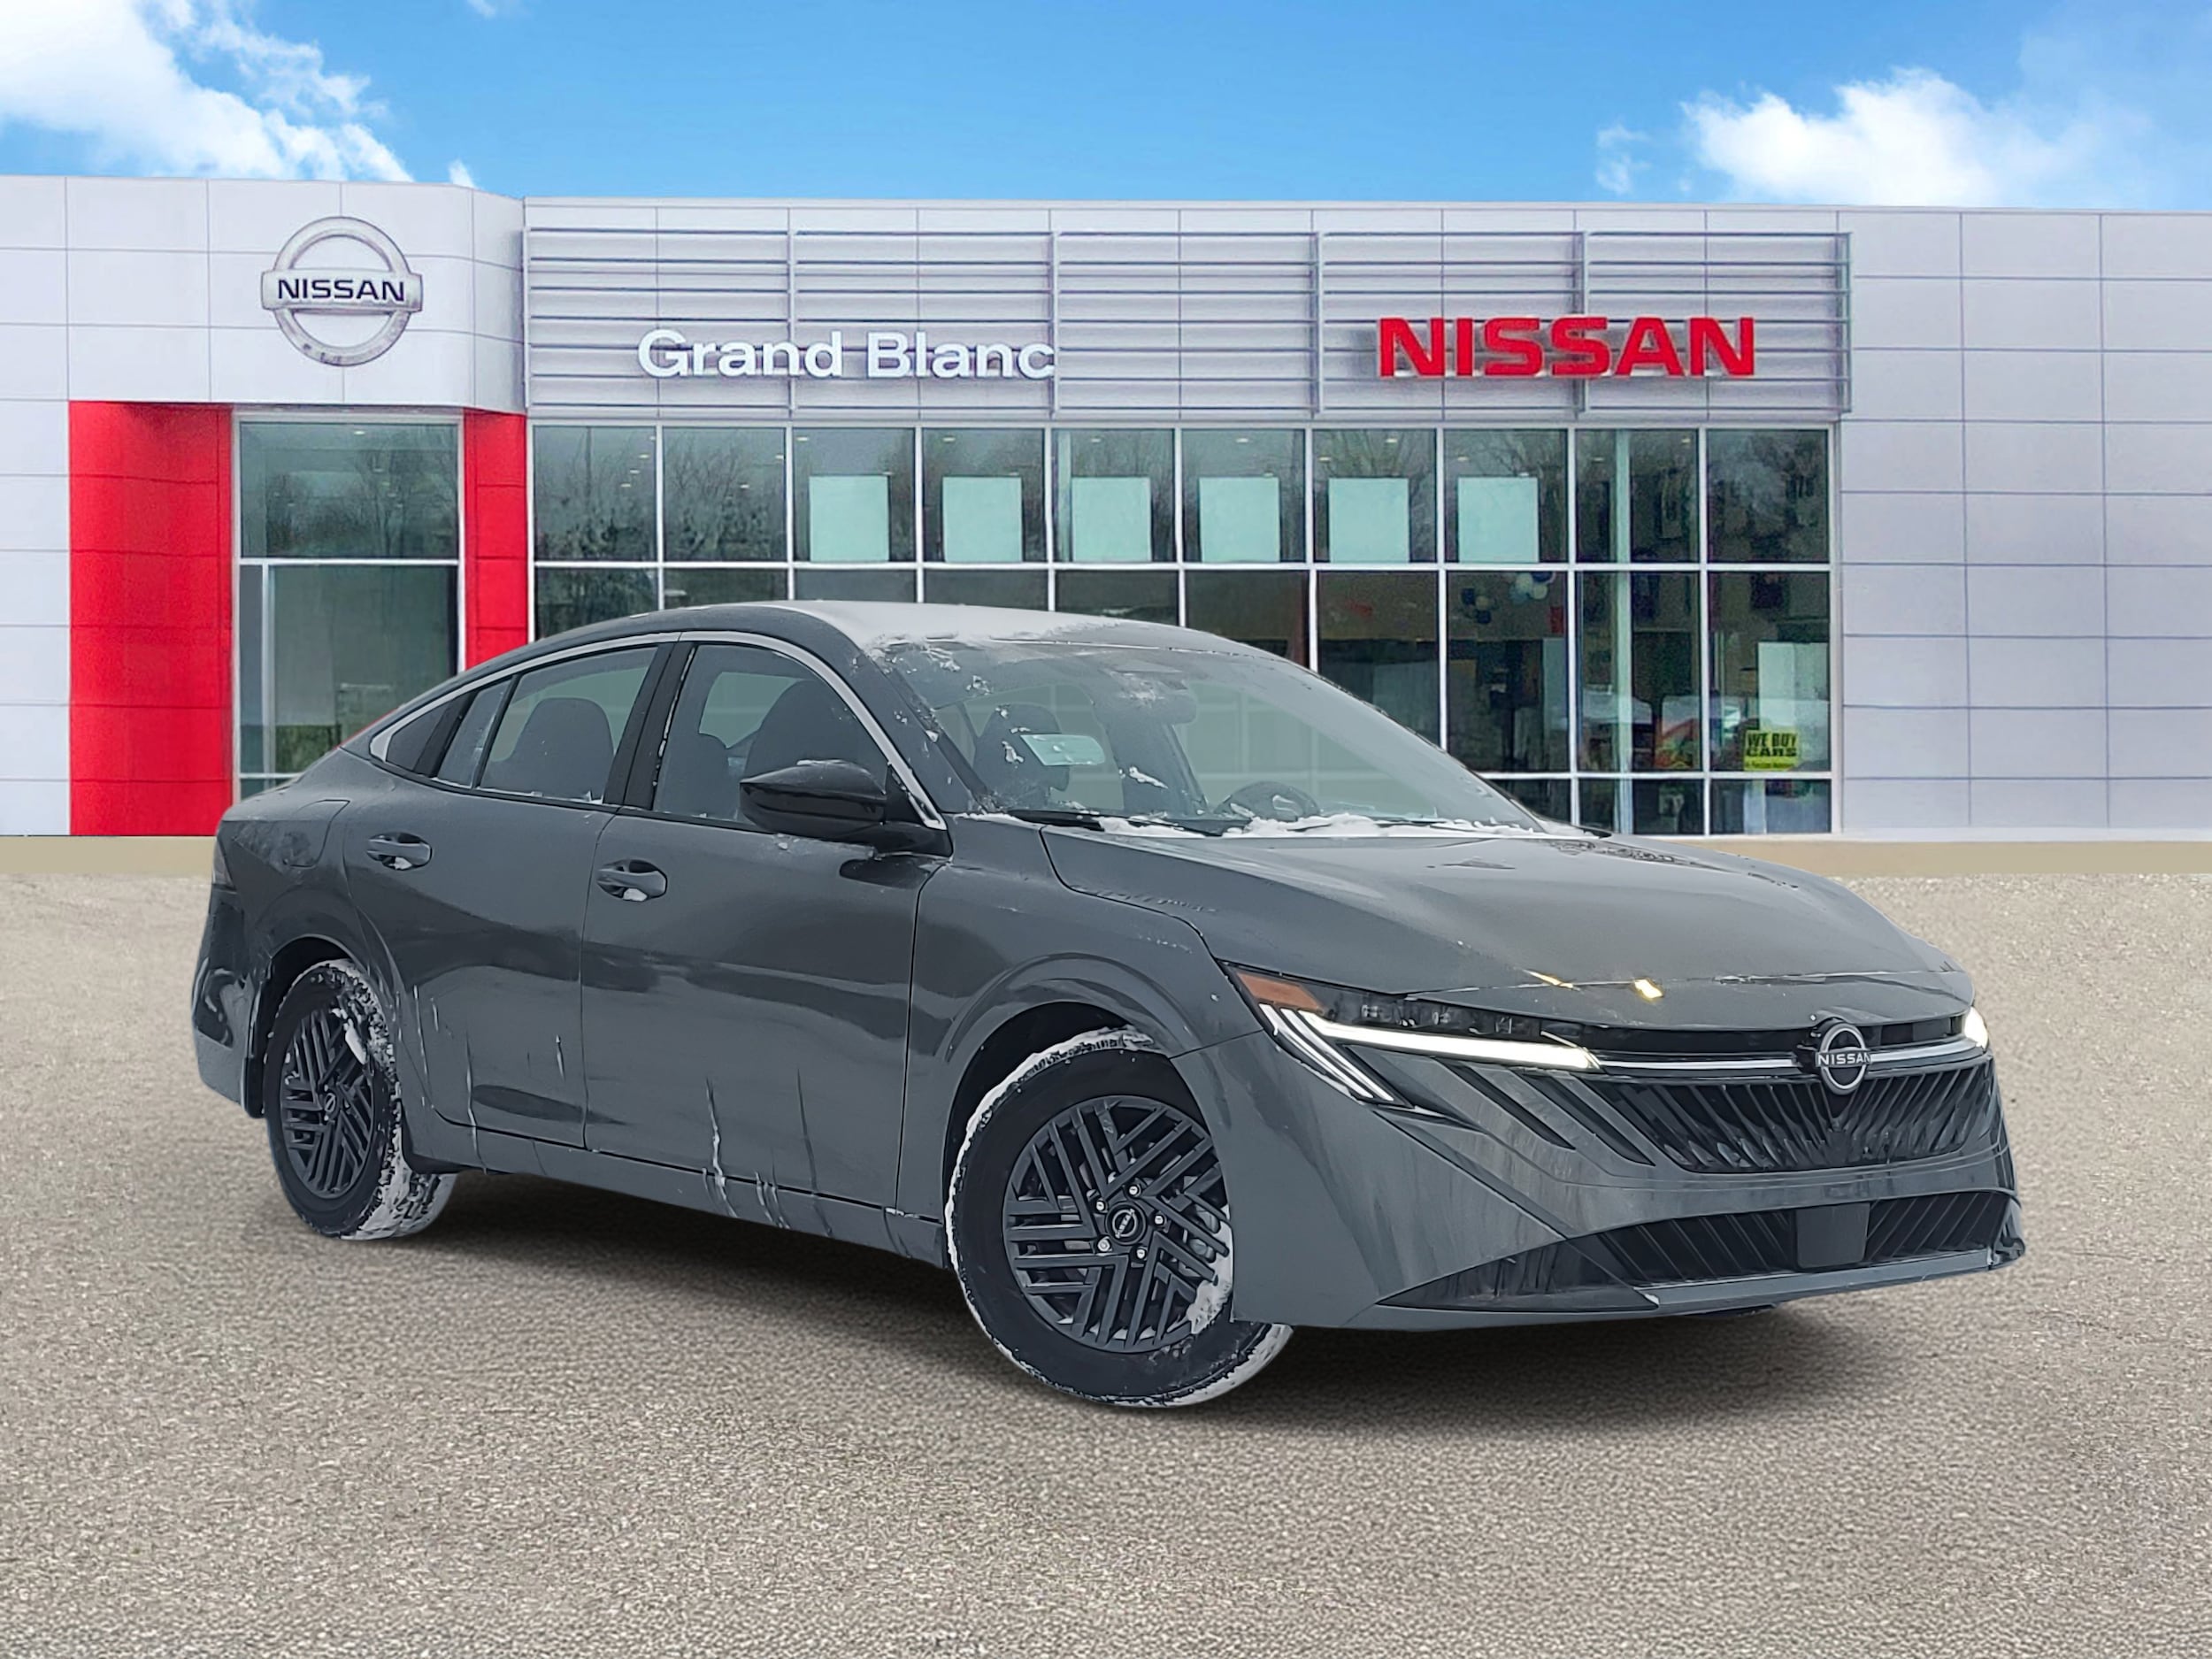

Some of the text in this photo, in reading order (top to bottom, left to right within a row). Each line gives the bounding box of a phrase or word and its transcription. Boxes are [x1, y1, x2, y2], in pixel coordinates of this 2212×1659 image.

[278, 278, 405, 302] NISSAN
[637, 329, 1056, 380] Grand Blanc
[1379, 316, 1755, 377] NISSAN
[1747, 733, 1797, 747] WE BUY
[1747, 748, 1797, 757] CARS
[1817, 1052, 1872, 1066] NISSAN
